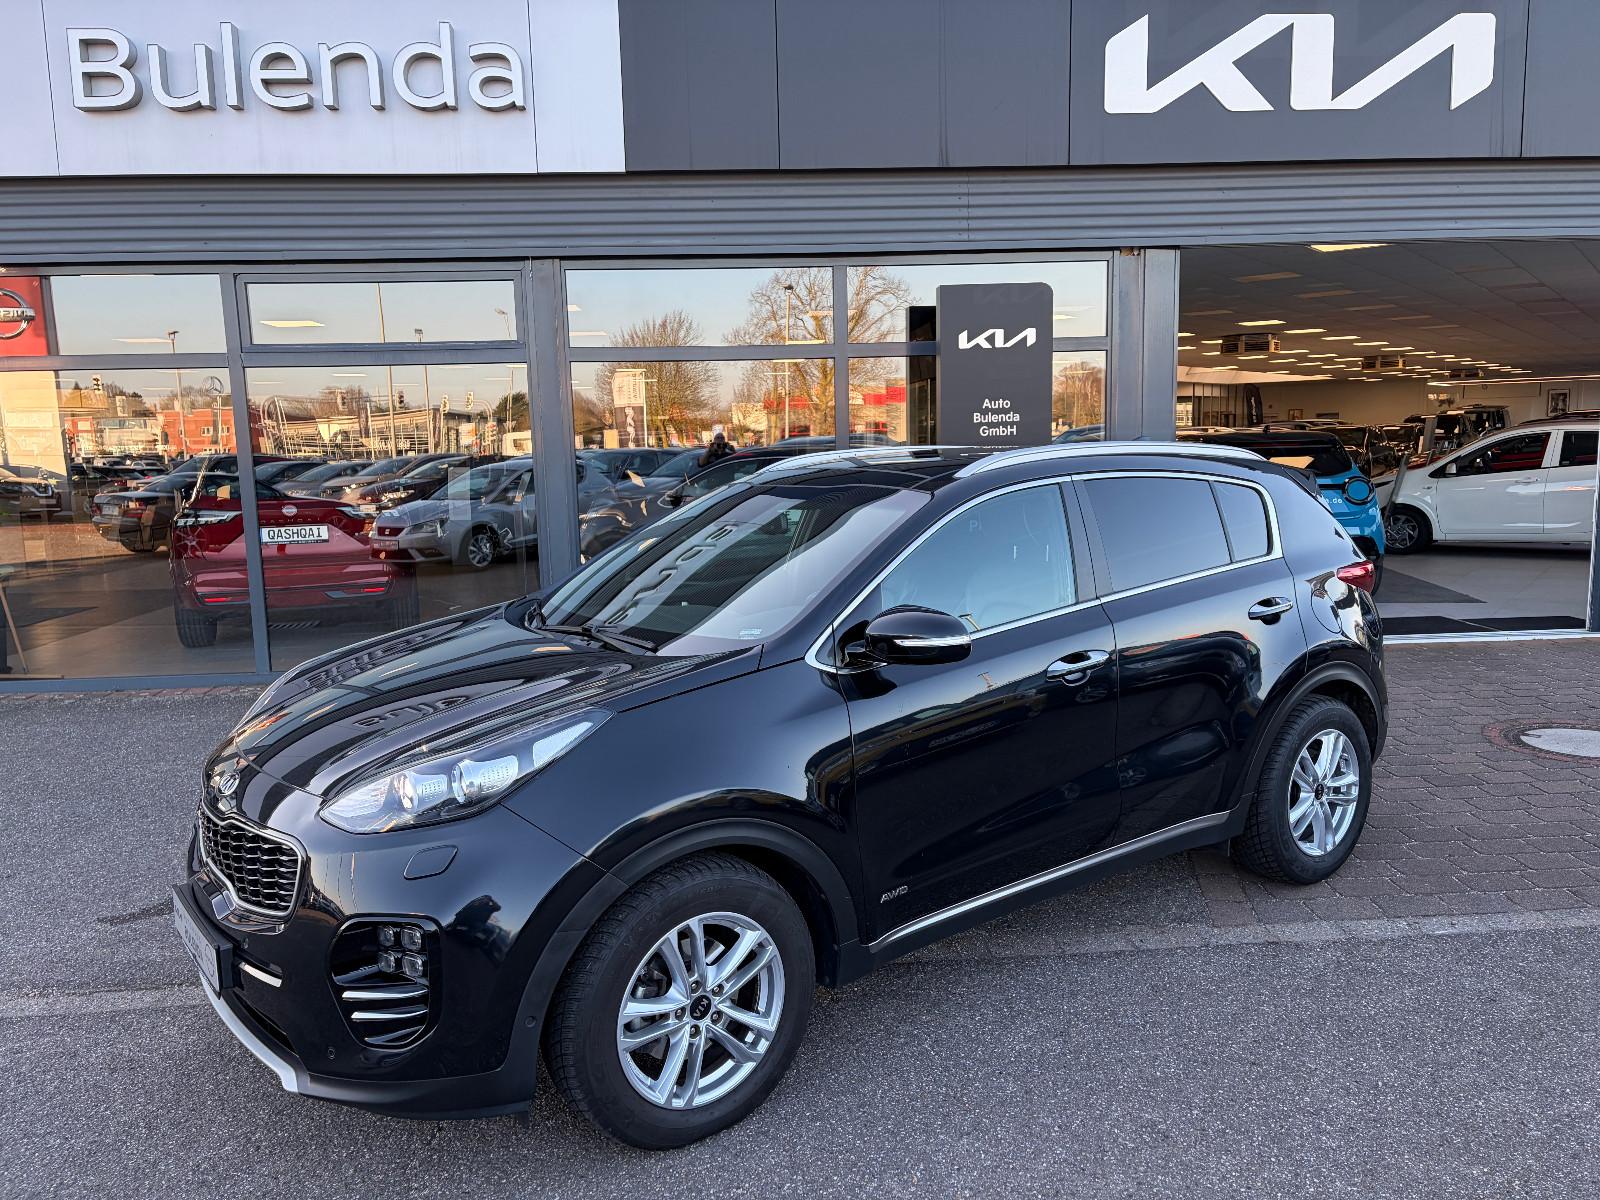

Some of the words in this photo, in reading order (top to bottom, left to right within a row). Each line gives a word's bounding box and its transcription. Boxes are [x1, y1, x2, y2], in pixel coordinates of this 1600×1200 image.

[66, 21, 526, 112] Bulenda
[1104, 12, 1497, 114] KIA
[958, 327, 1037, 350] KIA
[982, 398, 1011, 409] Auto
[973, 412, 1020, 424] Bulenda
[979, 425, 1017, 437] GmbH
[267, 527, 323, 540] QASHQAI
[880, 885, 909, 904] AWD
[693, 998, 709, 1017] KIA
